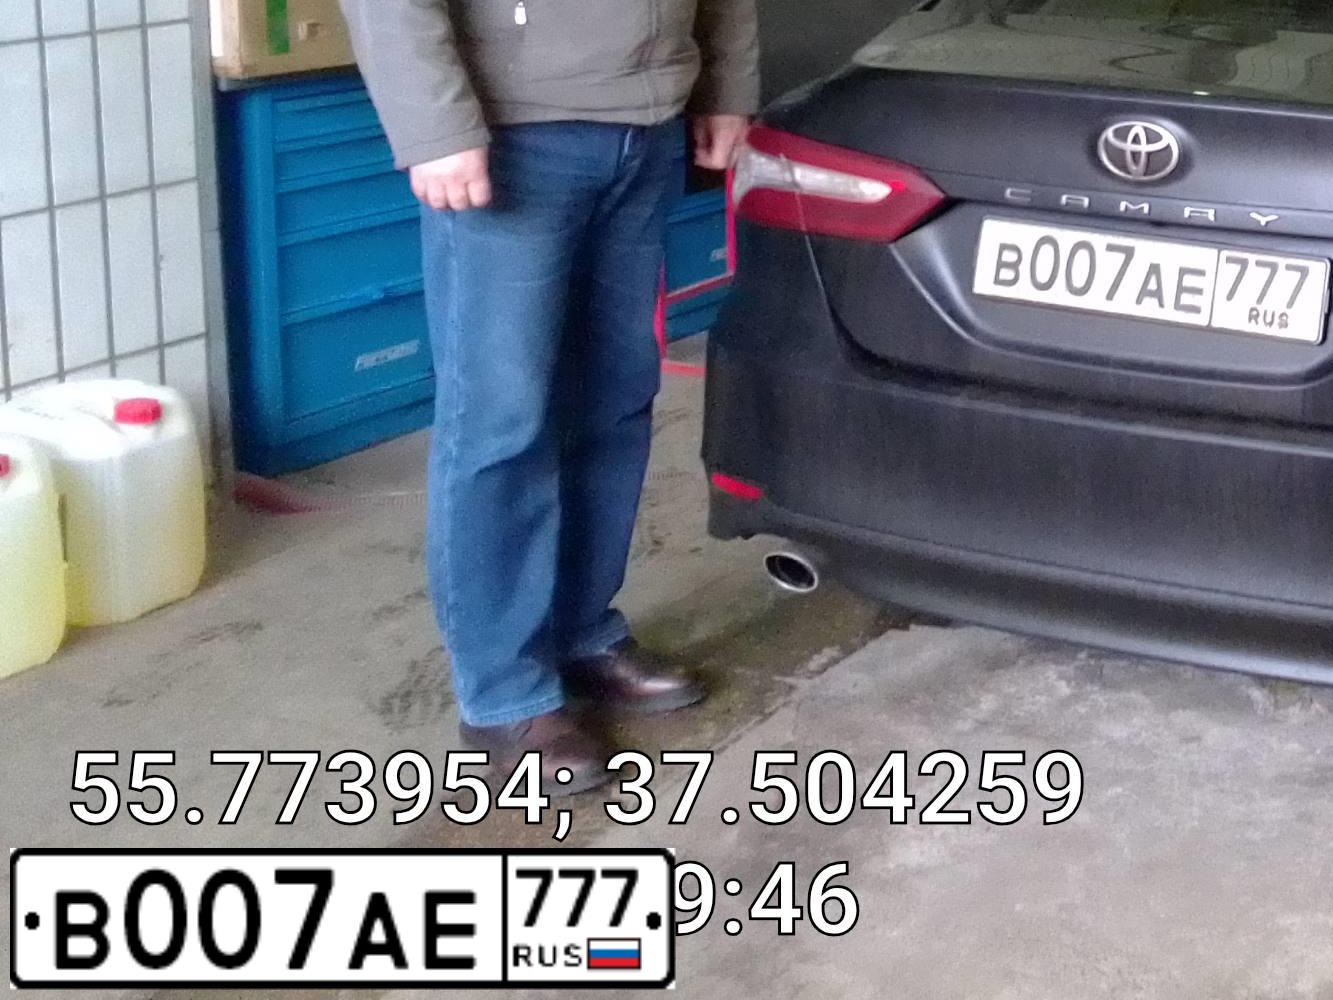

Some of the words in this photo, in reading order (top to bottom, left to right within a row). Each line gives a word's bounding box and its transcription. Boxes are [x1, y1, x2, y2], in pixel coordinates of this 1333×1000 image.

[1005, 187, 1279, 227] CAMRY
[1225, 257, 1310, 310] 777
[1247, 307, 1290, 330] RUS
